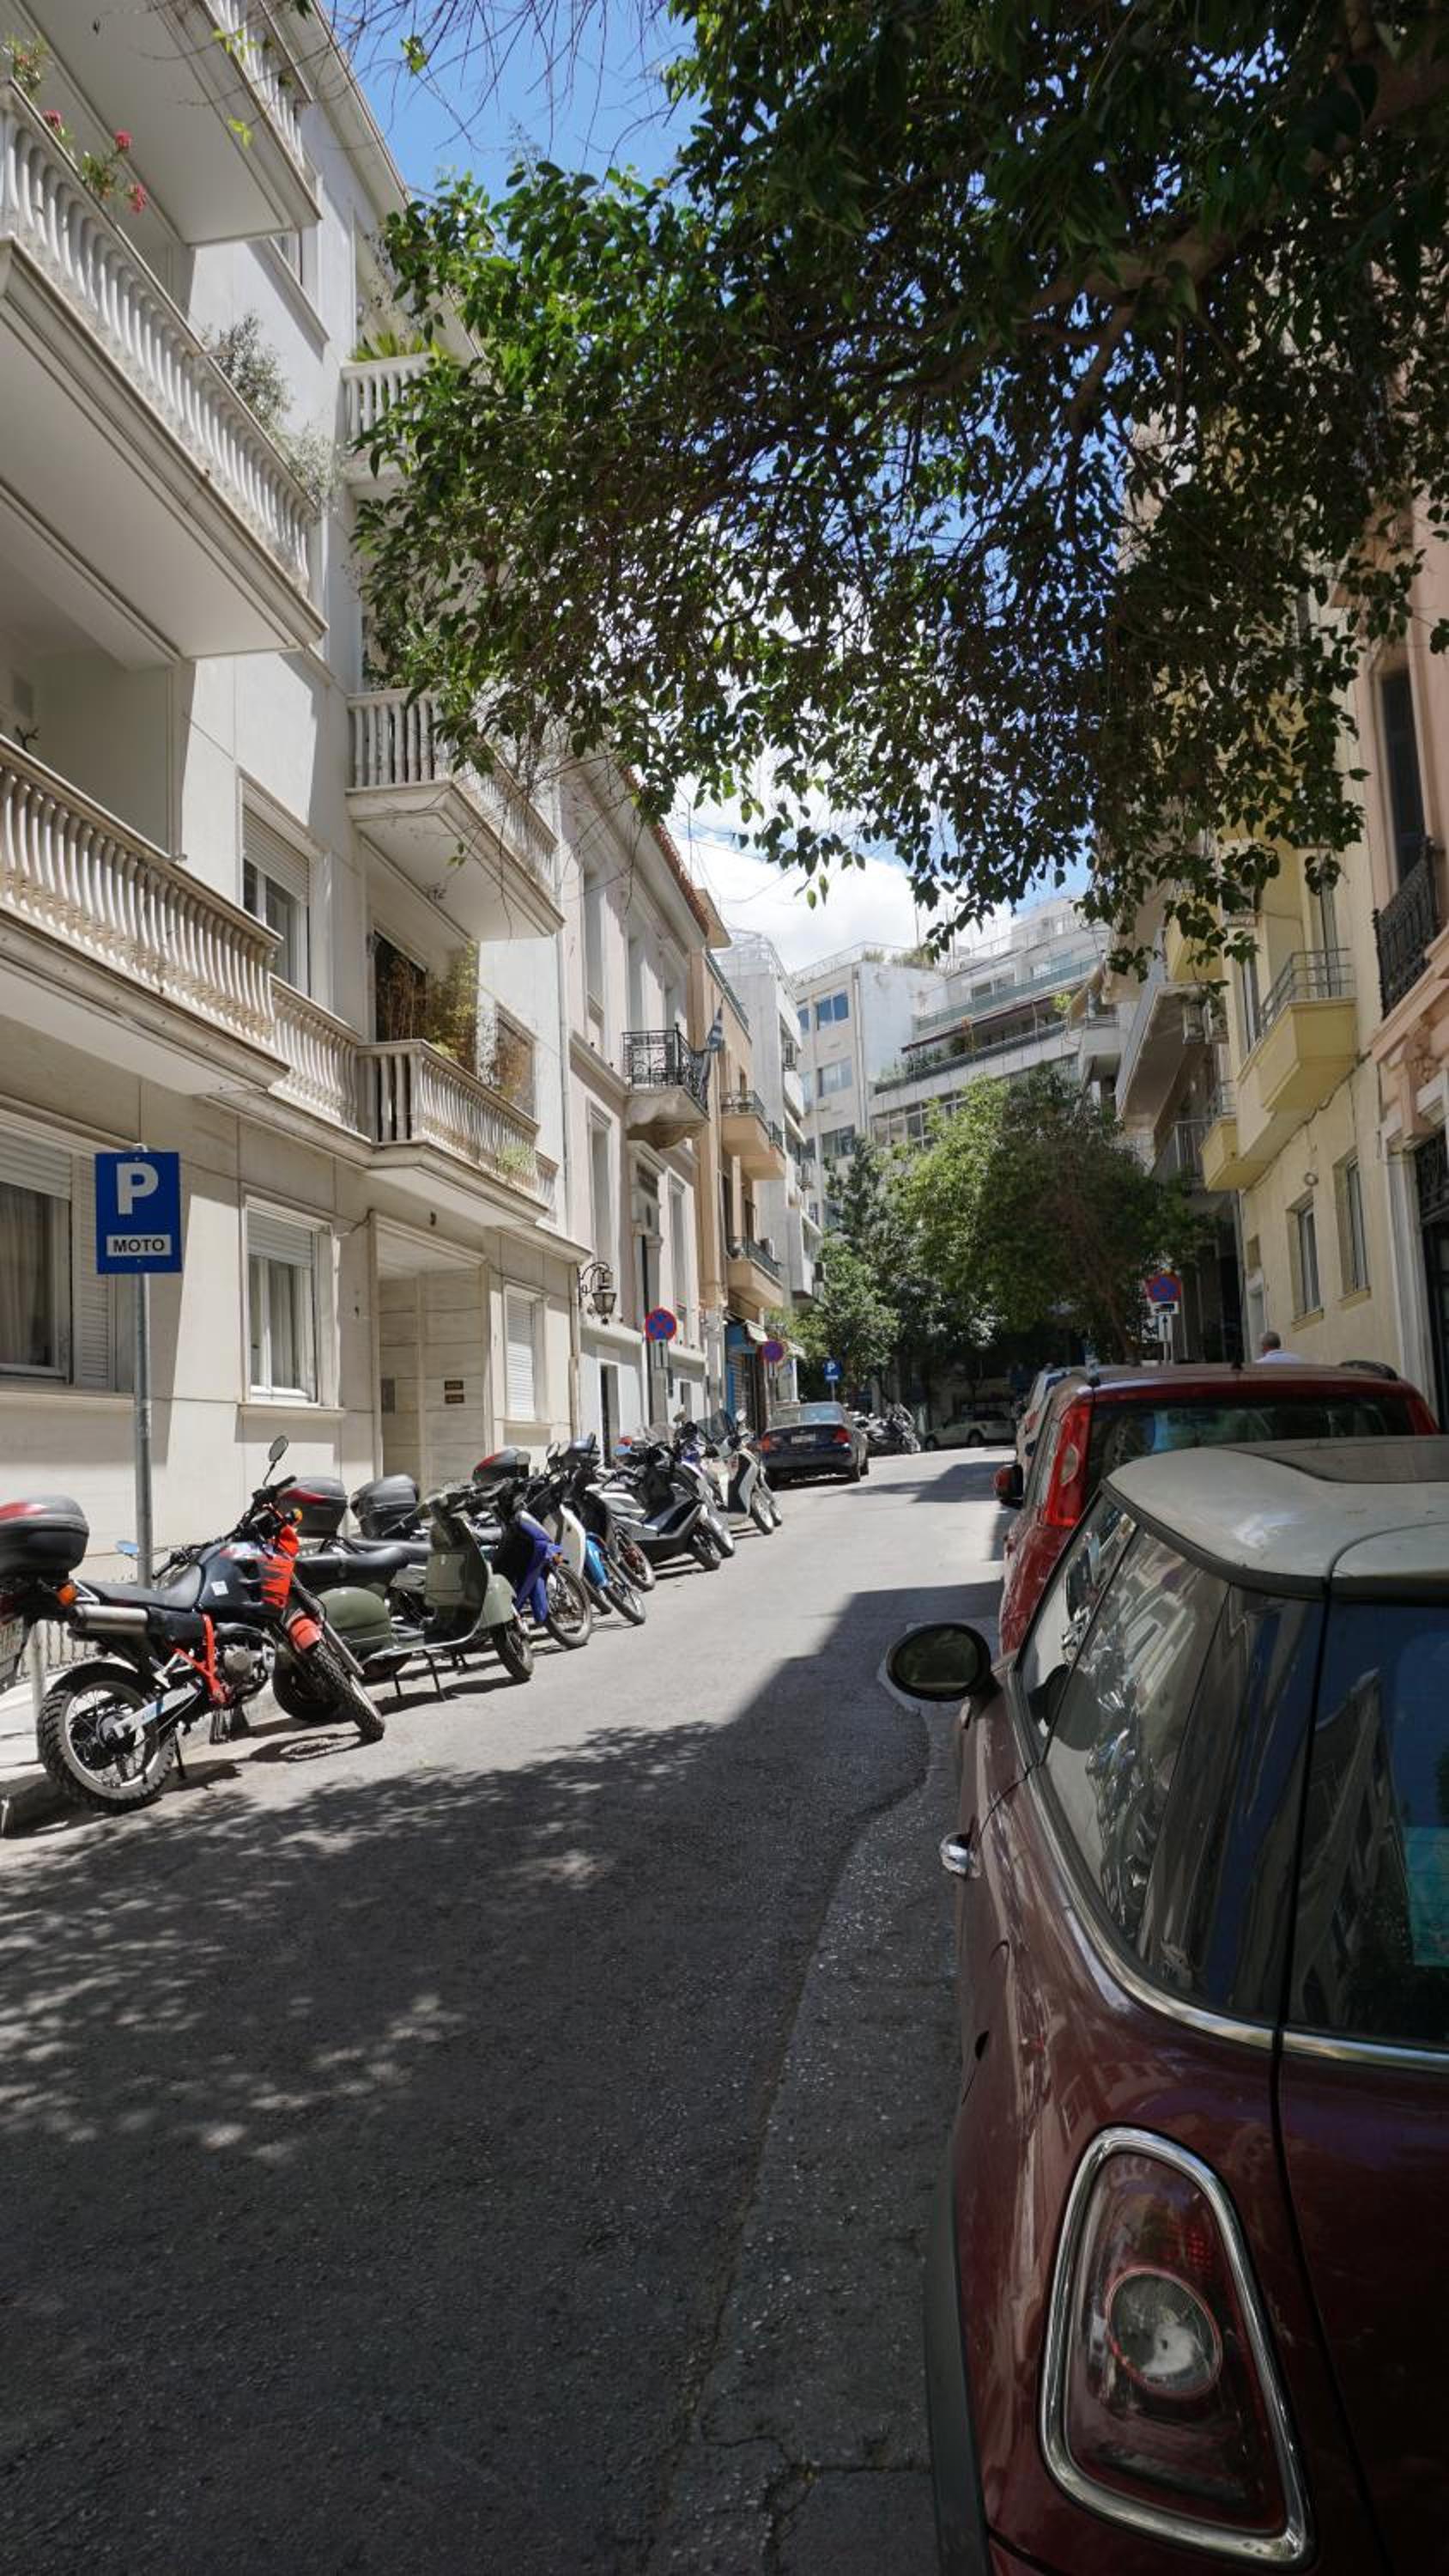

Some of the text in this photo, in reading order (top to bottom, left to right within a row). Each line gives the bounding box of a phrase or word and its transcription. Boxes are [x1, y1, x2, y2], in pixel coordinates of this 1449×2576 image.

[117, 1163, 159, 1214] P
[113, 1238, 165, 1253] MOTO
[827, 1363, 836, 1373] P
